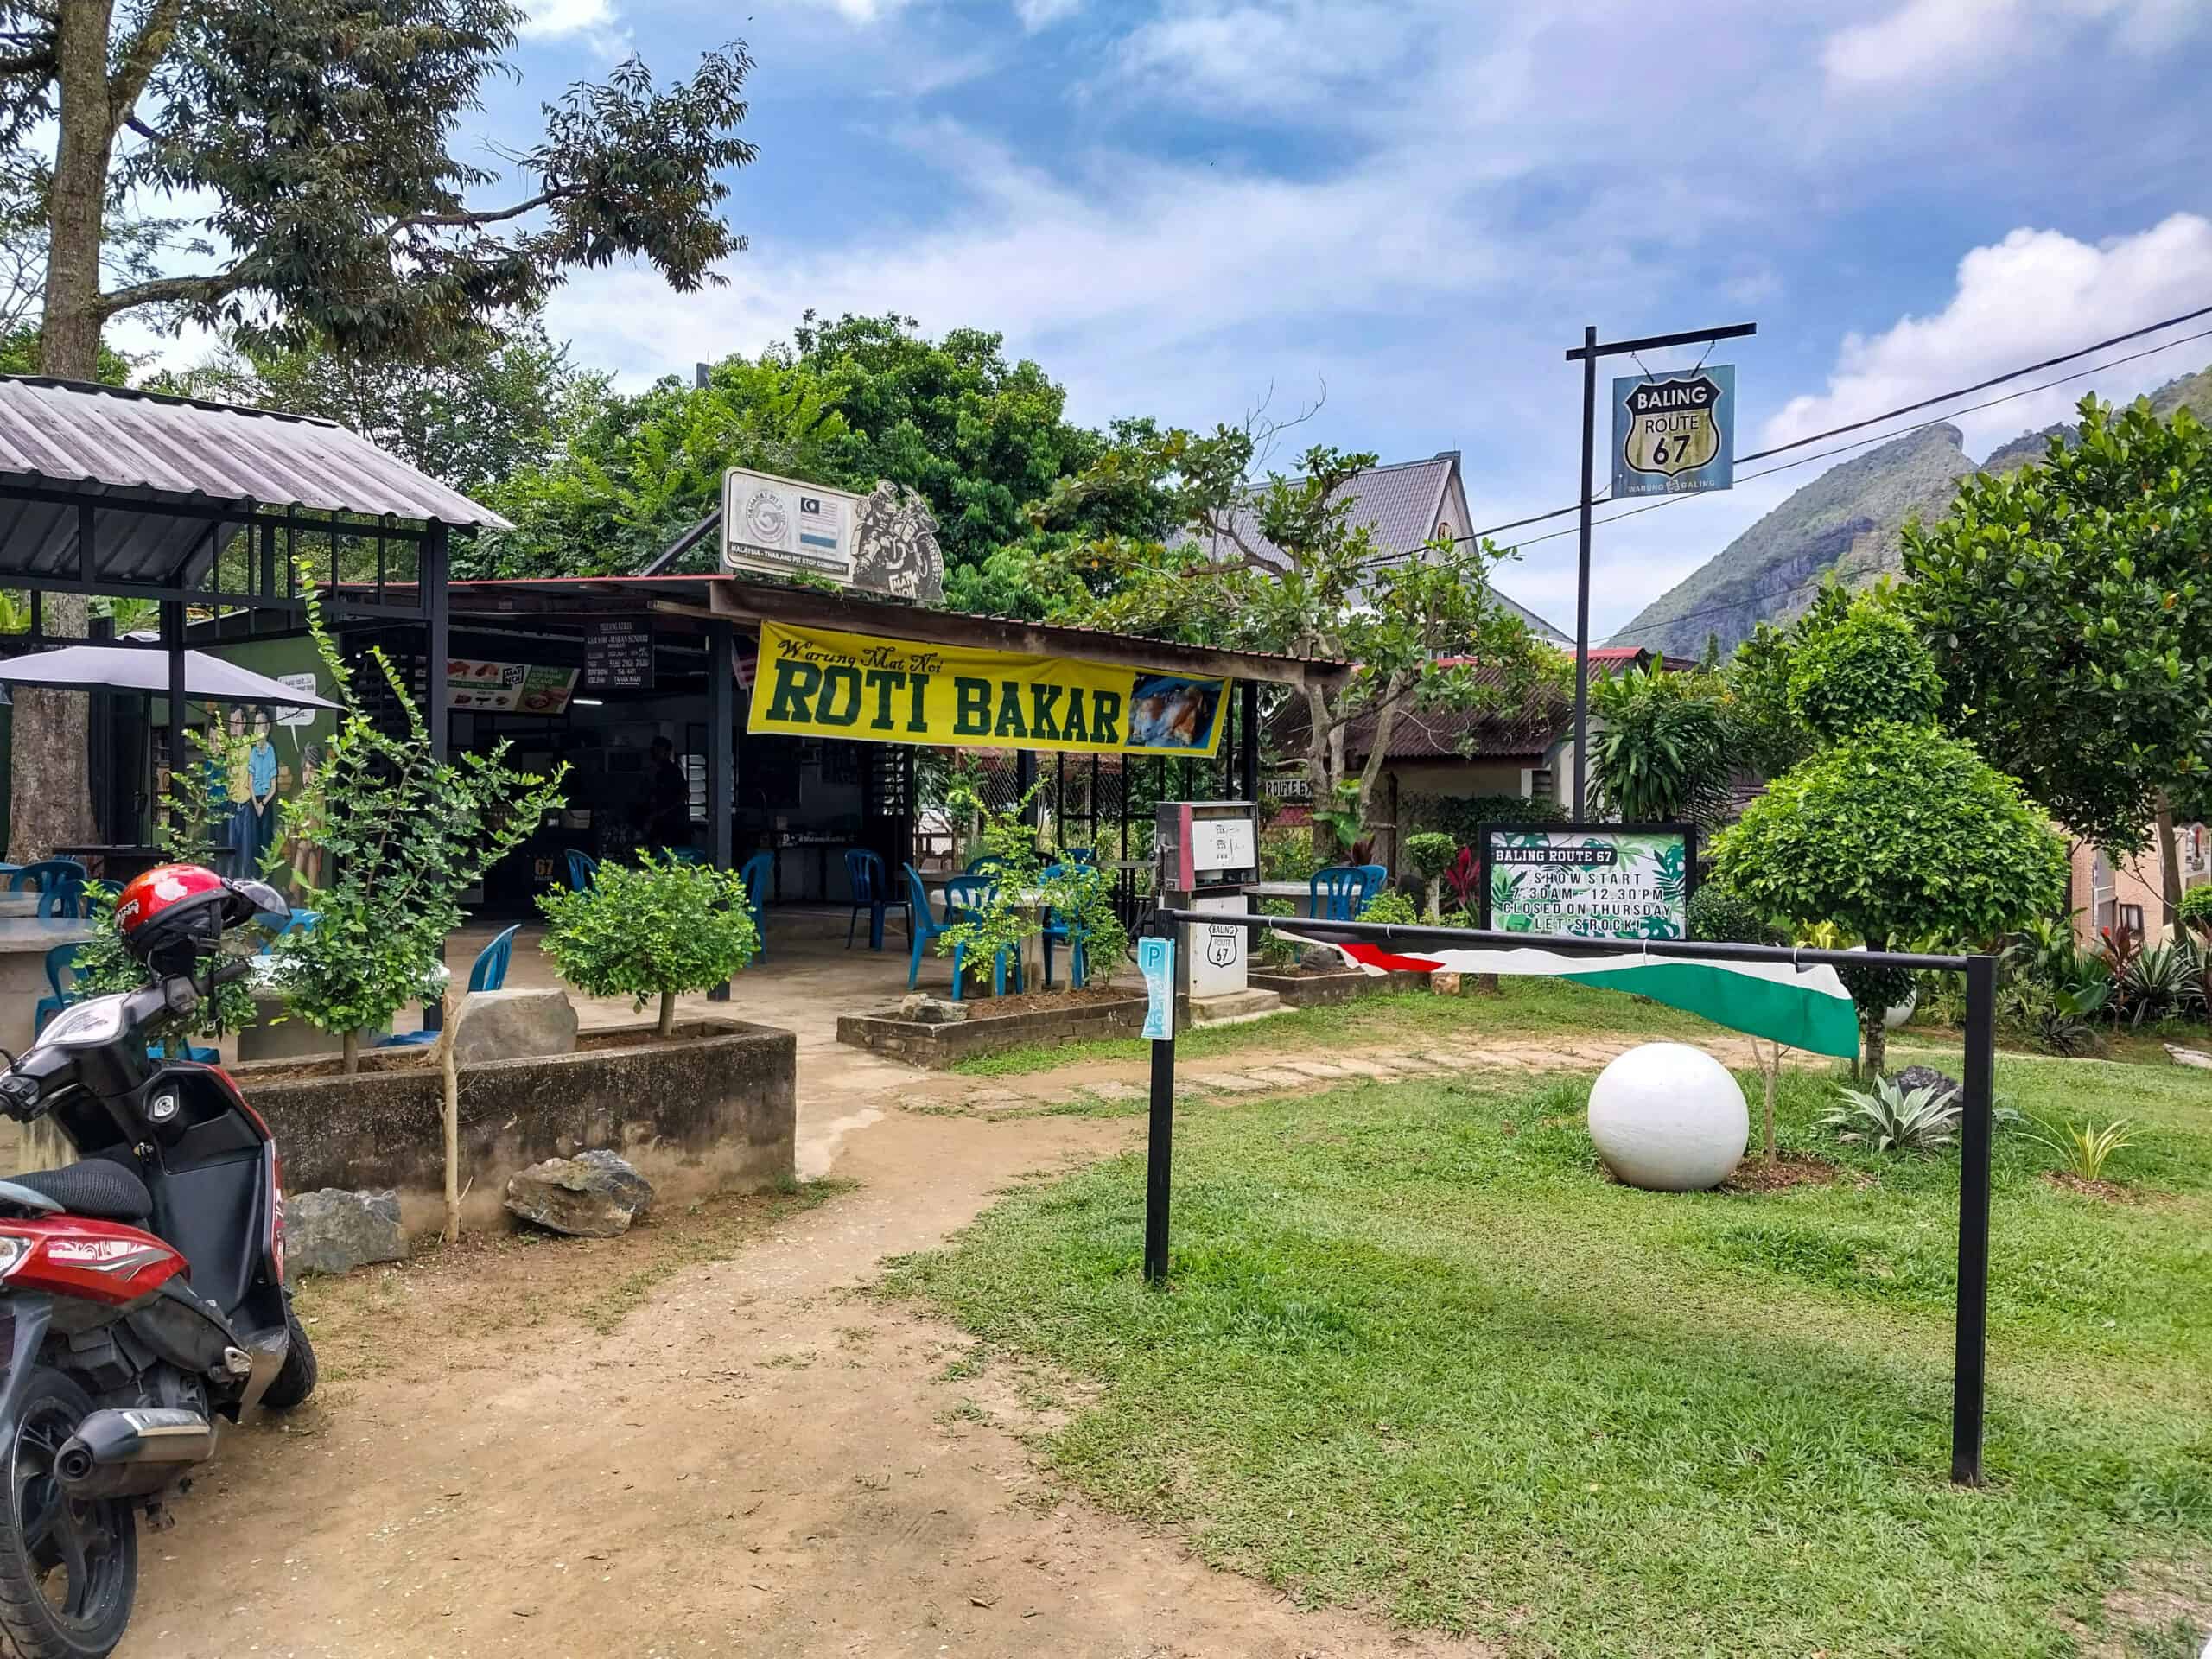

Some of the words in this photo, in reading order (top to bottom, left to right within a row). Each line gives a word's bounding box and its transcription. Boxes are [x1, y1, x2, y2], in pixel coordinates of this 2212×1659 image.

[1637, 386, 1707, 409] BALING
[1645, 415, 1699, 434] ROUTE
[1653, 435, 1691, 465] 67
[731, 545, 760, 557] MALAYSIA
[764, 550, 791, 563] THAILAND
[778, 639, 856, 668] Warung
[860, 645, 904, 671] Mat
[910, 652, 944, 673] Noi
[766, 658, 931, 733] ROTI
[953, 677, 1122, 744] BAKAR
[1267, 780, 1297, 797] ROUTE
[1496, 849, 1545, 861] BALING
[1549, 850, 1592, 861] ROUTE
[1596, 850, 1612, 862] 67
[1534, 873, 1581, 885] SHOW
[1588, 873, 1642, 886] START
[1503, 903, 1560, 914] CLOSED
[1567, 904, 1586, 914] ON
[1592, 904, 1670, 916] THURSDAY
[1212, 925, 1235, 935] BALING
[1590, 919, 1640, 931] ROCK!
[1214, 938, 1231, 947] ROUTE
[1148, 945, 1161, 968] P
[1216, 948, 1229, 962] 67
